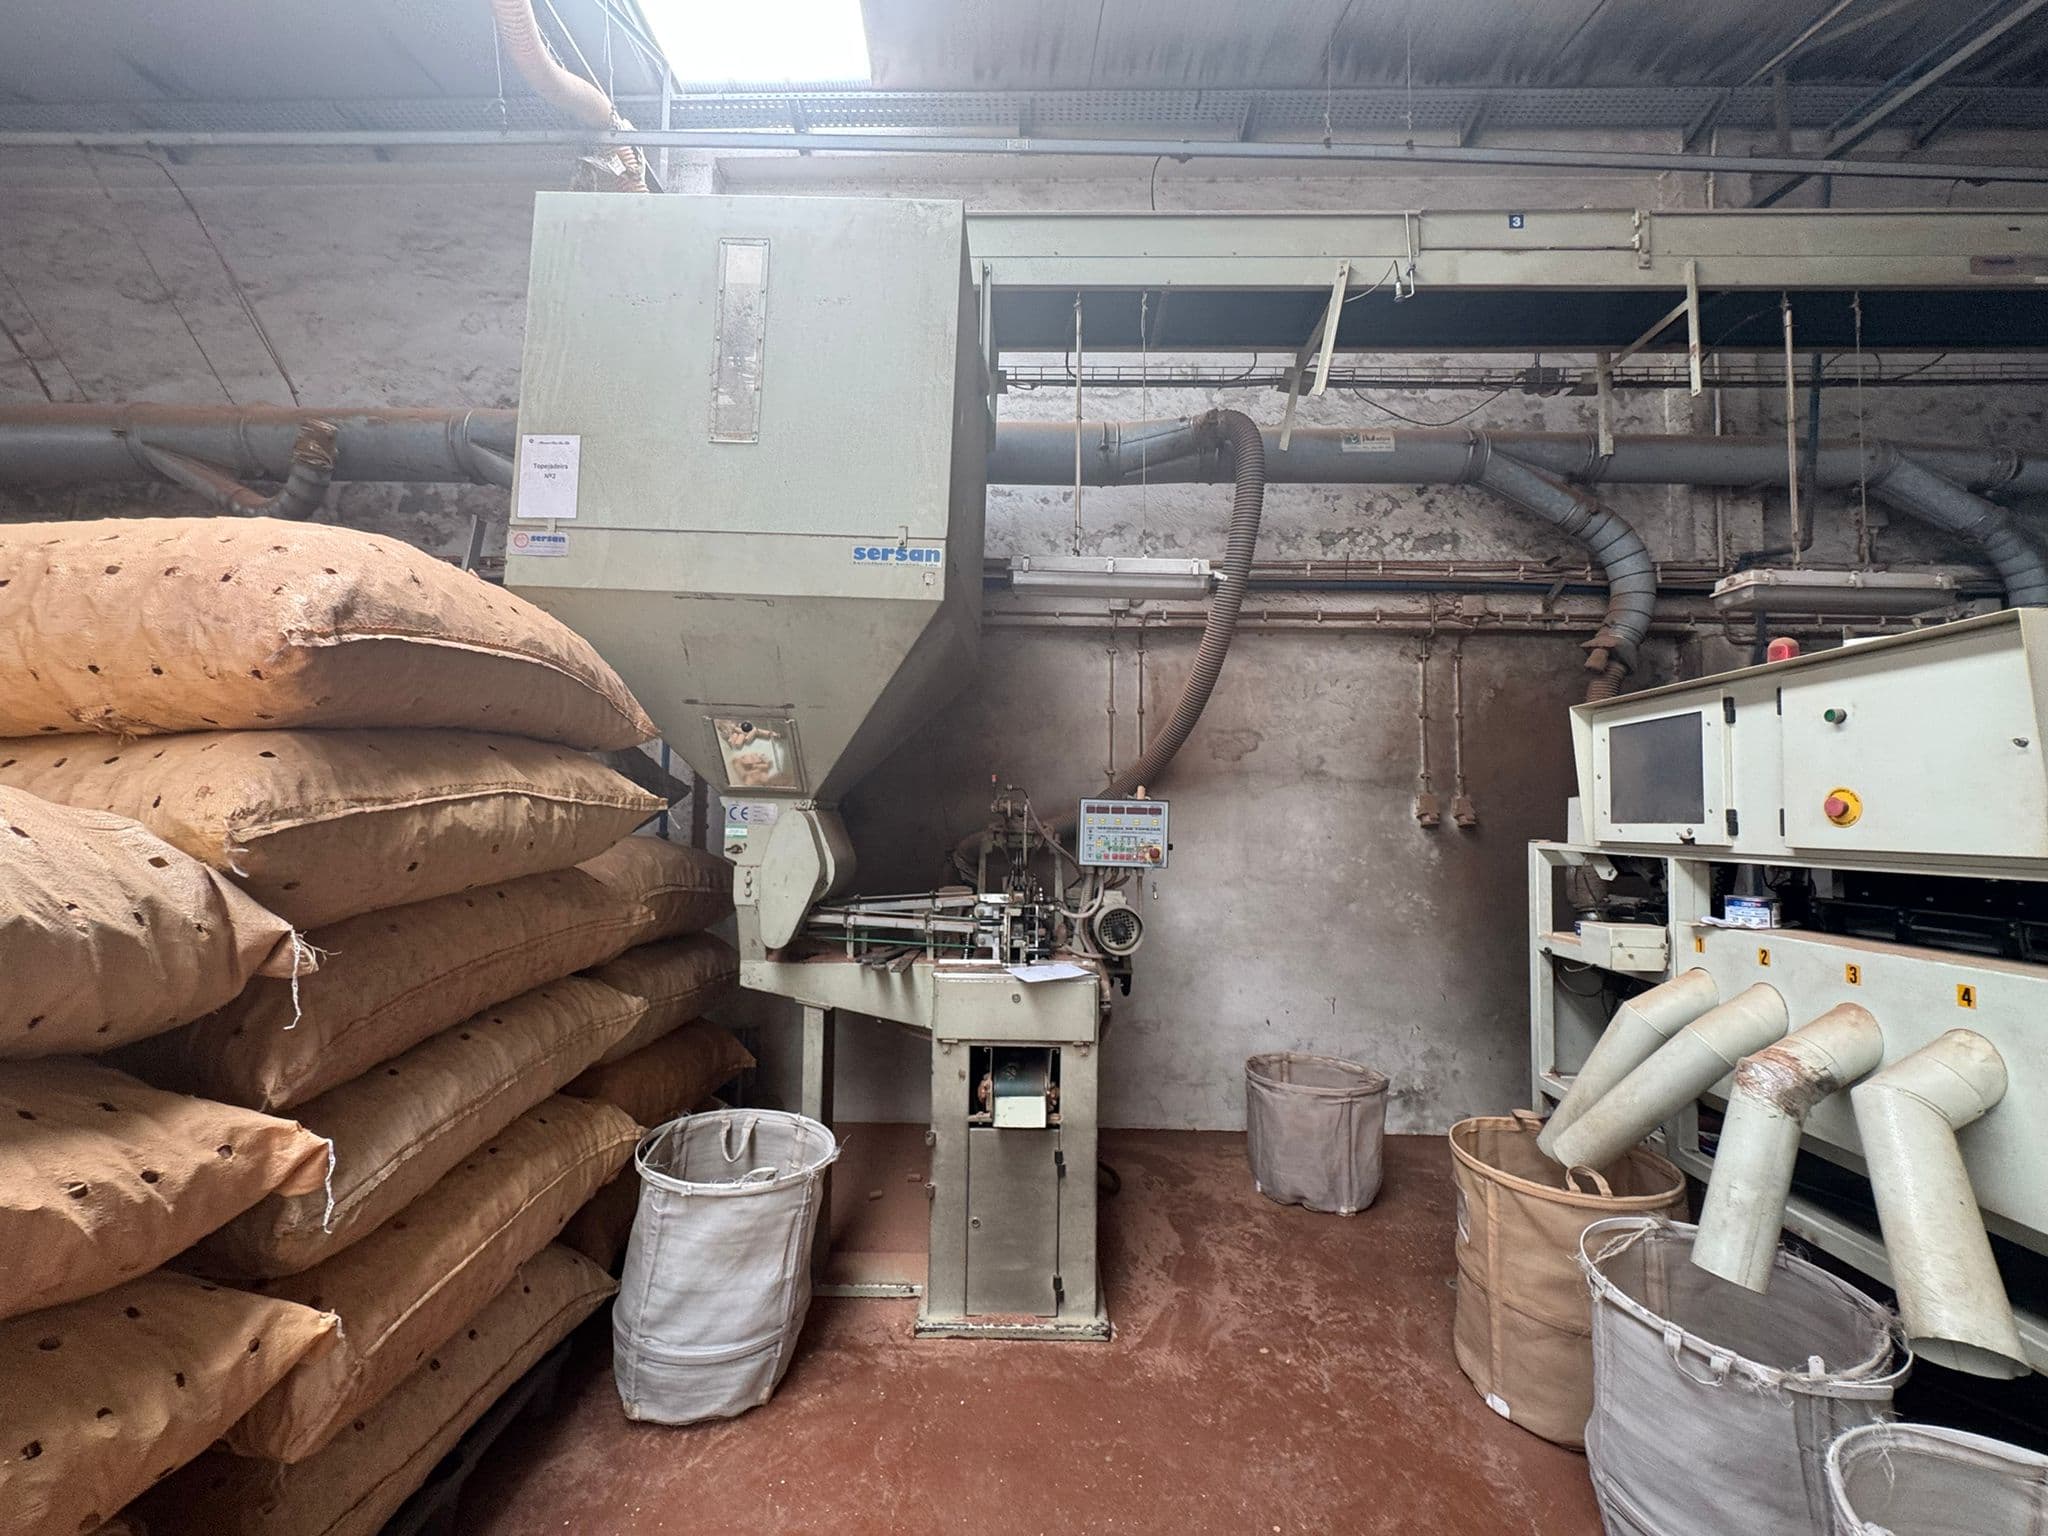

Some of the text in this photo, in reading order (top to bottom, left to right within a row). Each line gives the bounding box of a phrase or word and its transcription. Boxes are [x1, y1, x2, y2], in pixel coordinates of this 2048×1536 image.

[1512, 216, 1521, 227] 3
[530, 535, 566, 543] sersan
[853, 546, 941, 562] sersan
[1698, 938, 1703, 953] 1
[1760, 949, 1768, 965] 2
[1849, 966, 1858, 984] 3
[1961, 987, 1972, 1007] 4
